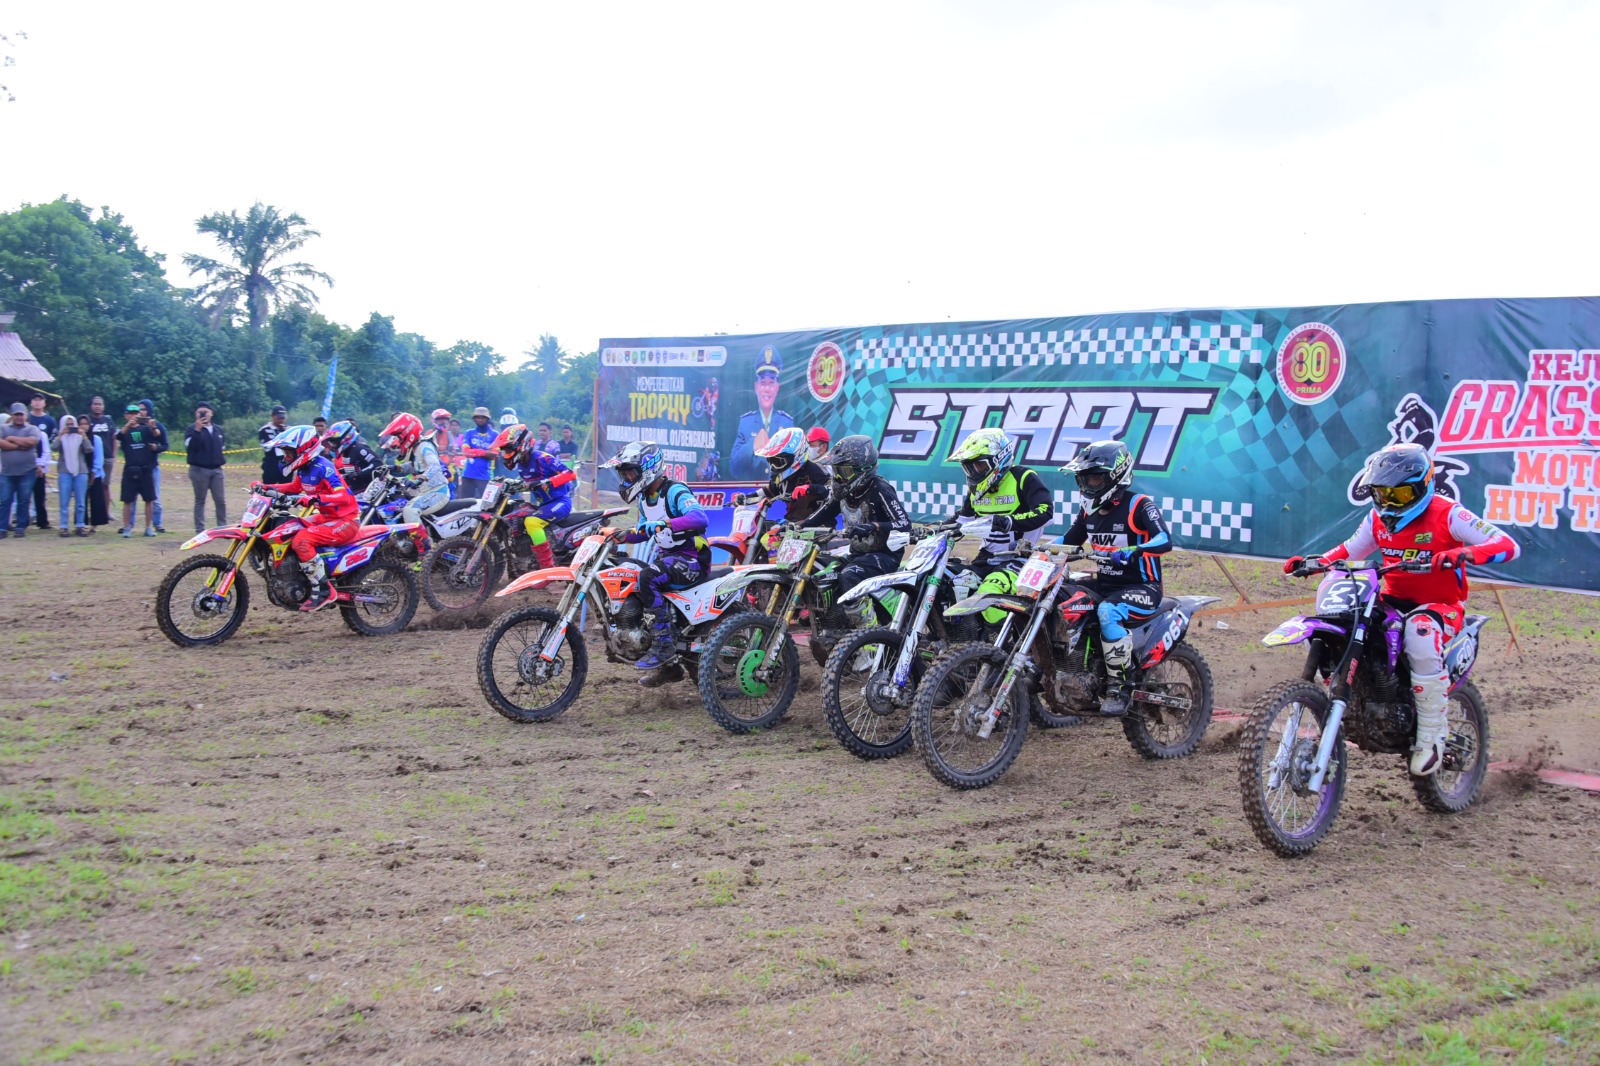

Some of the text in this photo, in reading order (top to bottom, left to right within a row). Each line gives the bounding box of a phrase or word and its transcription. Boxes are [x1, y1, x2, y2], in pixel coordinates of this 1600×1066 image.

[815, 356, 838, 386] 80
[1290, 341, 1331, 383] 80
[629, 393, 691, 425] TROPHY
[878, 388, 1217, 468] START
[1486, 488, 1600, 529] HUT T
[1020, 567, 1044, 587] 98
